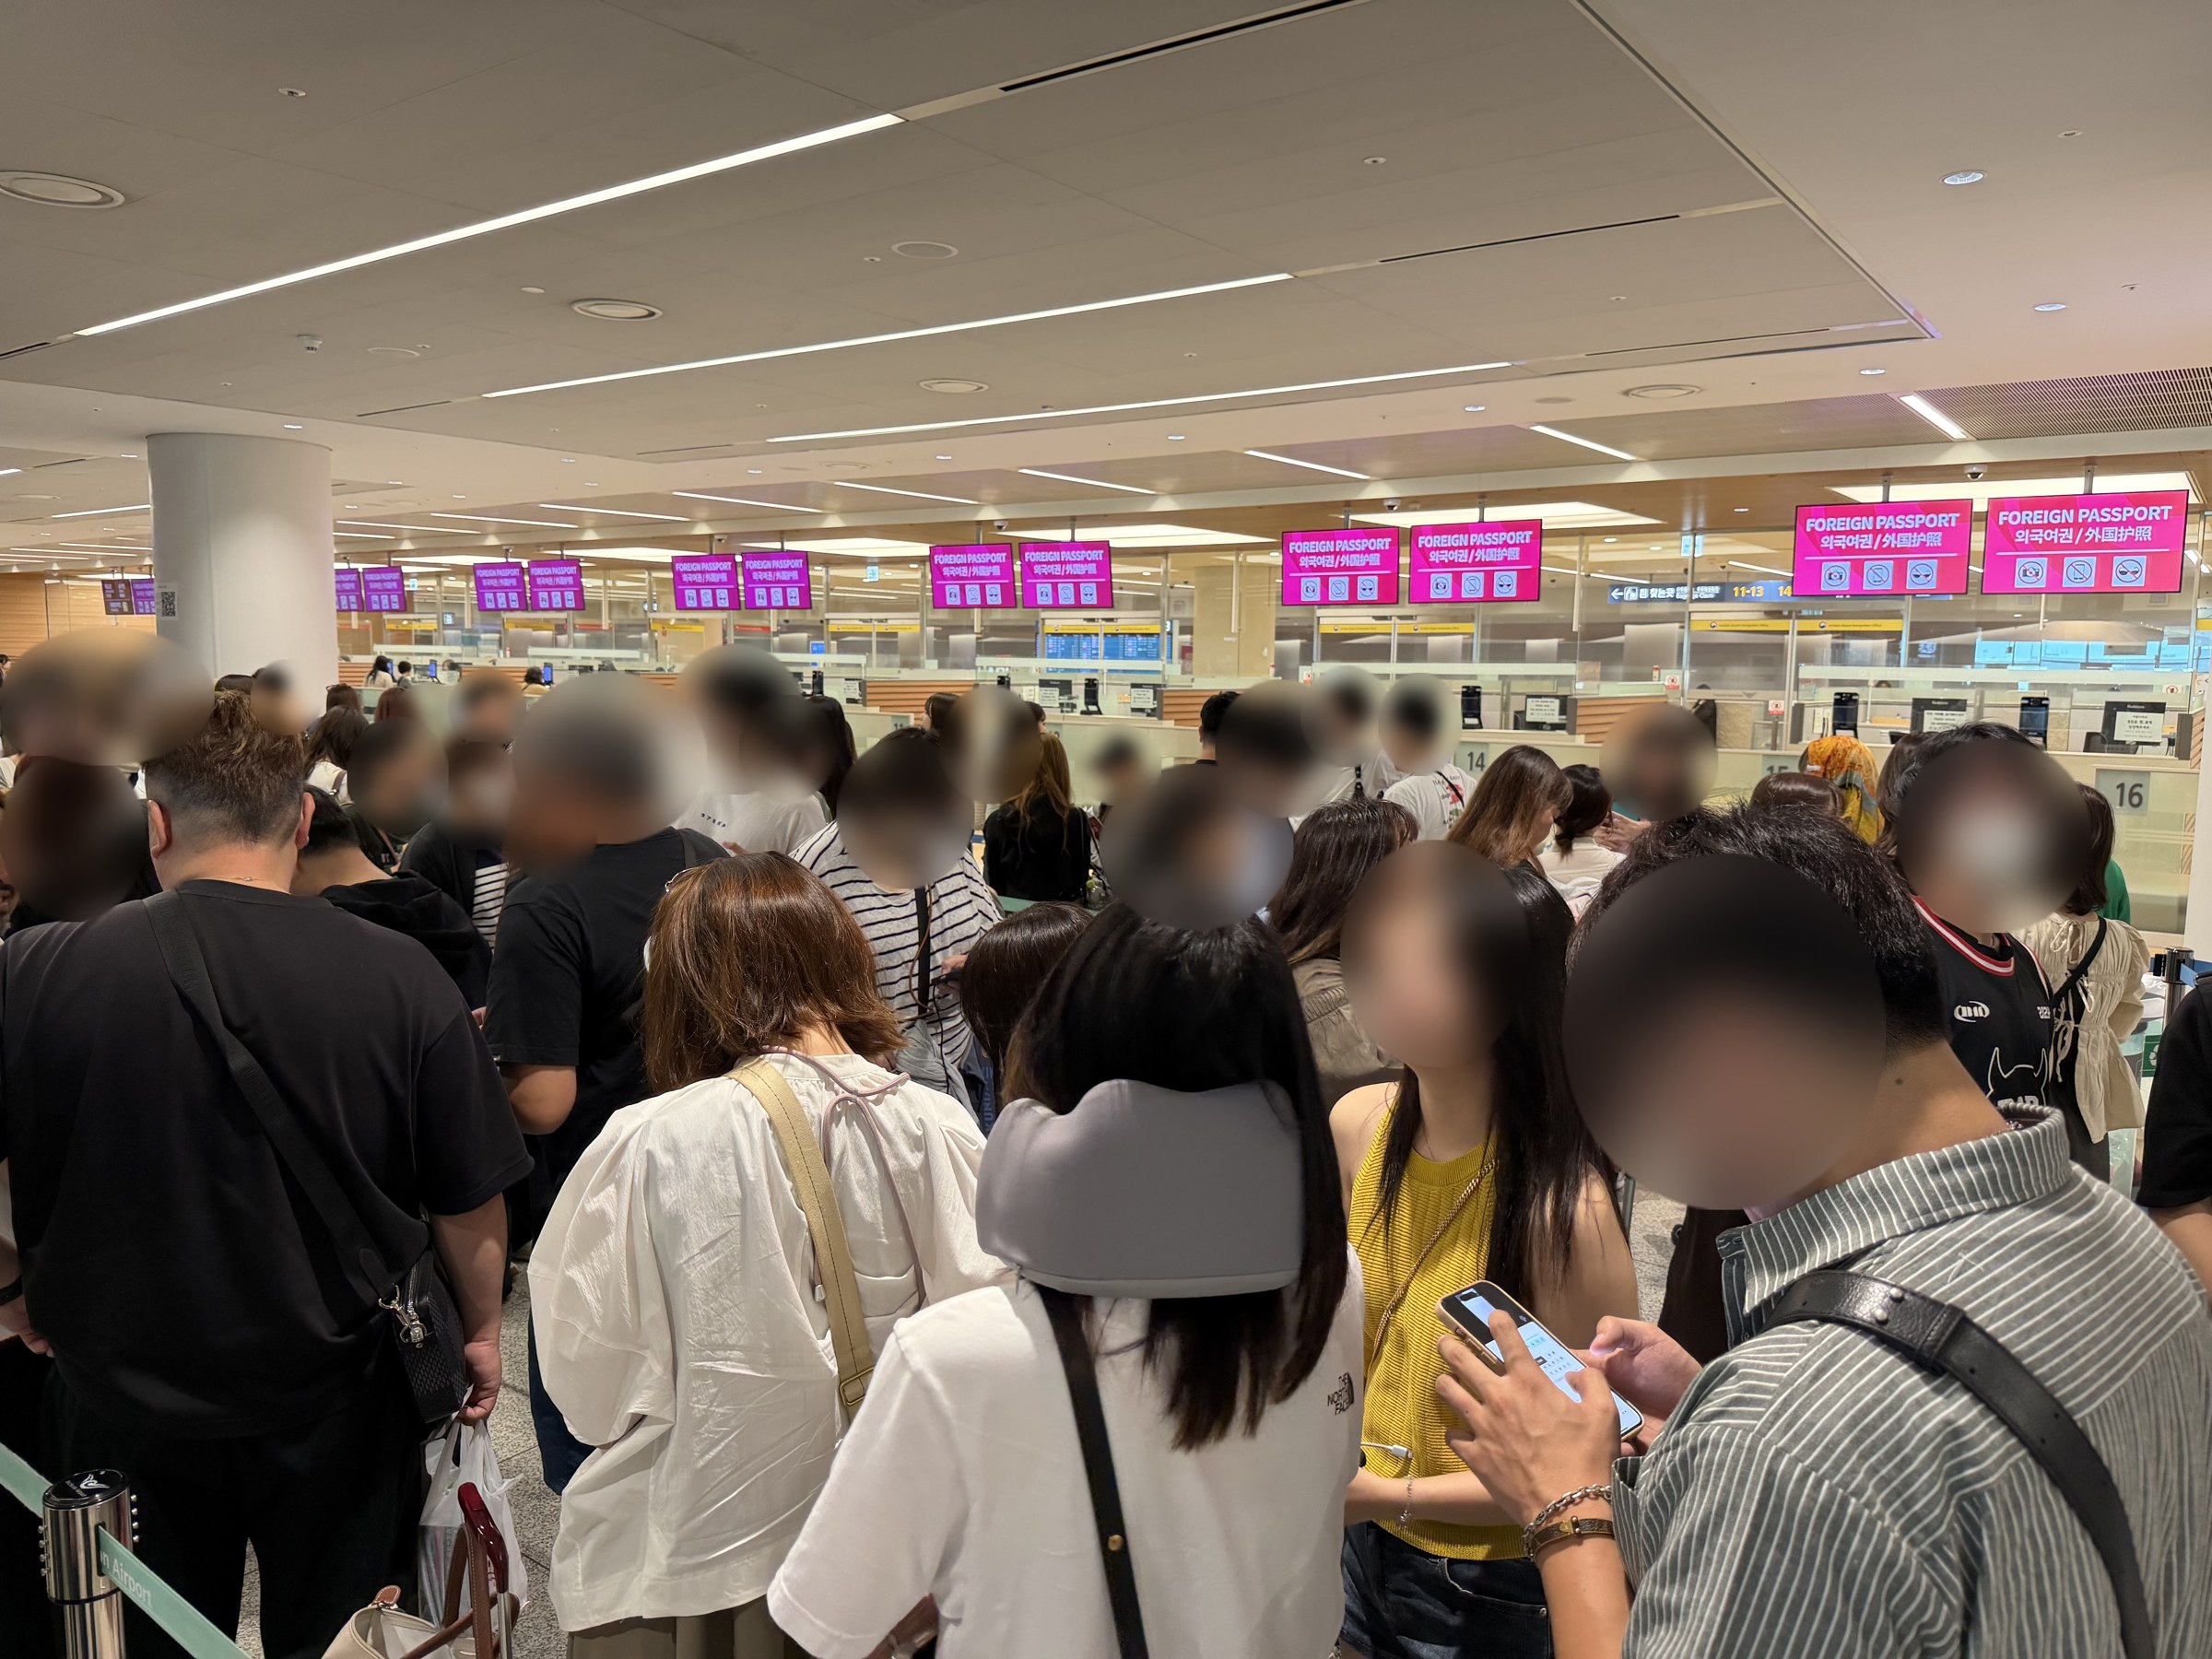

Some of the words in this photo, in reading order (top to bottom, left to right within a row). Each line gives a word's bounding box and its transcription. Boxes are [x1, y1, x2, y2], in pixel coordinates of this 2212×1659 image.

[1806, 516, 1873, 532] FOREIGN
[1877, 513, 1959, 529] PASSPORT
[1998, 510, 2073, 525] FOREIGN
[2078, 506, 2172, 523] PASSPORT
[1418, 534, 1468, 547] FOREIGN
[1470, 531, 1533, 546] PASSPORT
[1820, 534, 1873, 549] 외국여권
[2015, 528, 2073, 545] 외국여권
[1289, 541, 1334, 553] FOREIGN
[1335, 538, 1392, 552] PASSPORT
[934, 553, 966, 564] FOREIGN
[968, 553, 1006, 563] PASSPORT
[1025, 551, 1060, 562] FOREIGN
[1061, 550, 1103, 561] PASSPORT
[1733, 586, 1764, 598] 11-13
[1467, 751, 1486, 771] 14
[2116, 782, 2143, 808] 16
[112, 1558, 153, 1608] Airport
